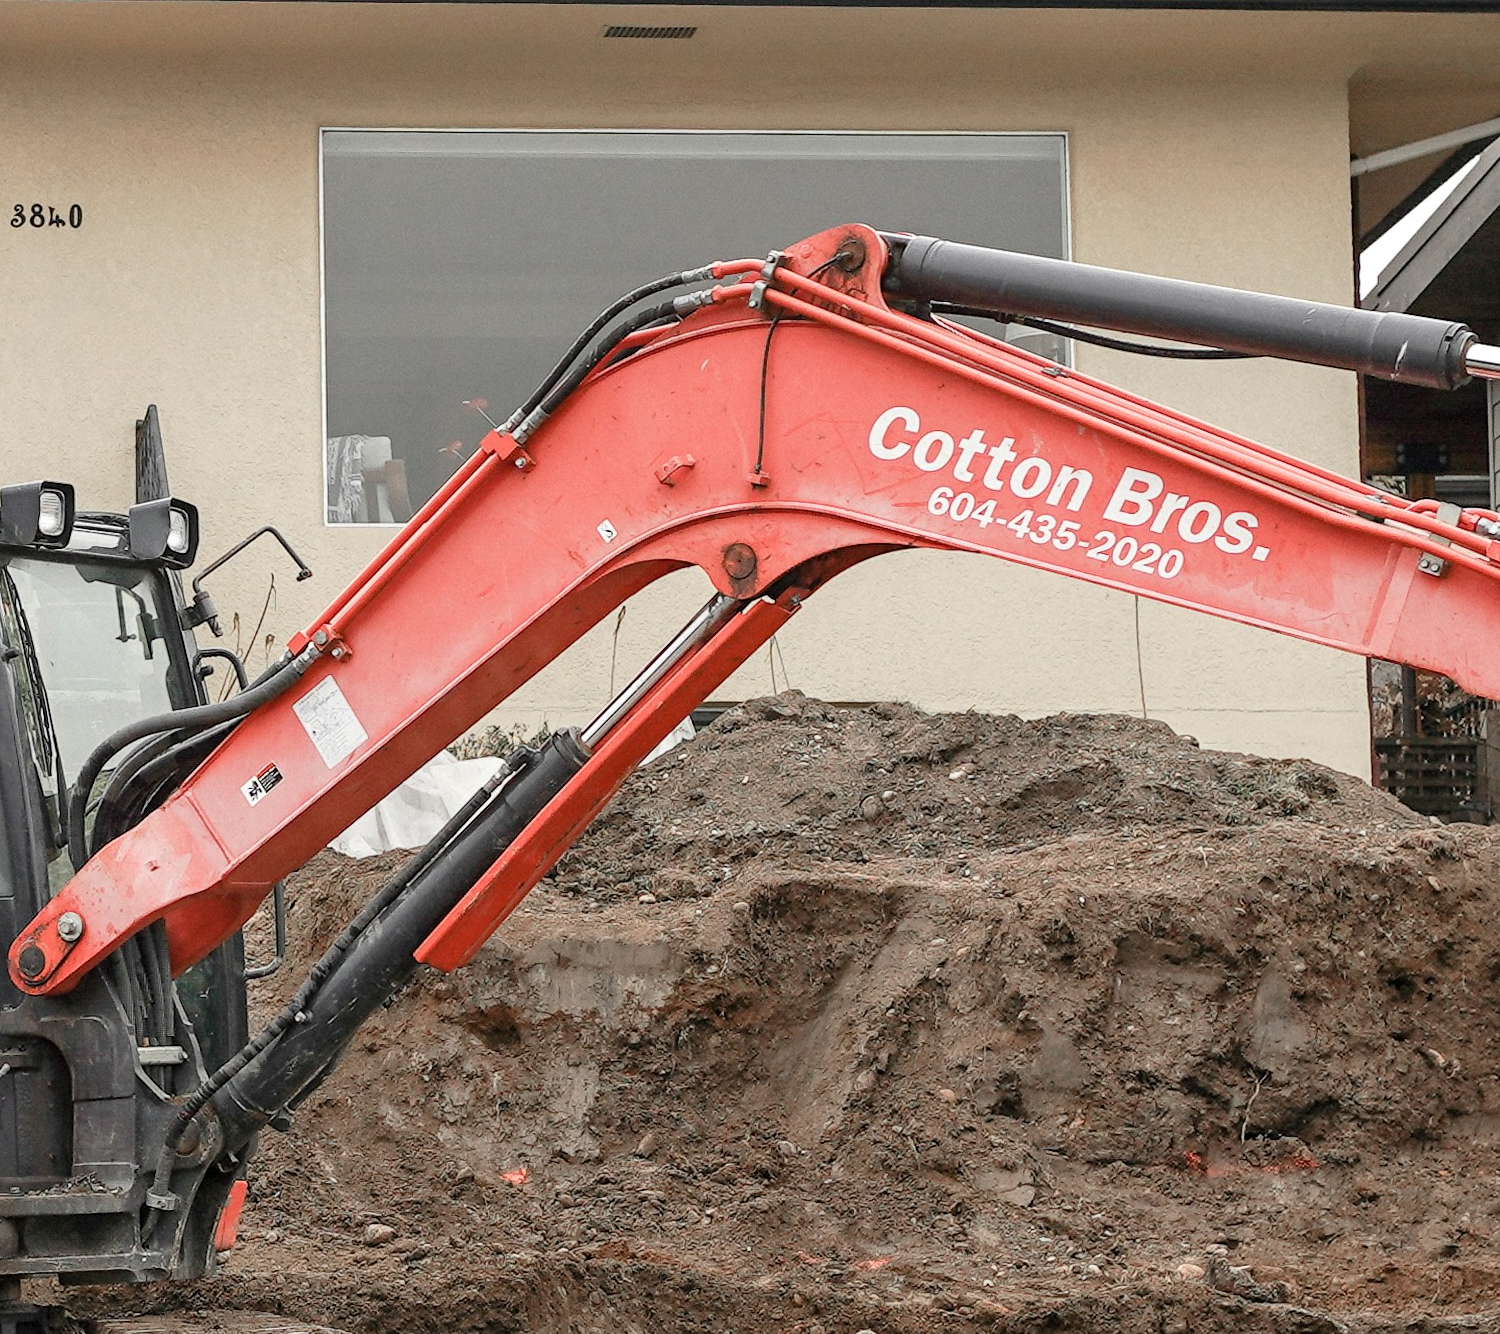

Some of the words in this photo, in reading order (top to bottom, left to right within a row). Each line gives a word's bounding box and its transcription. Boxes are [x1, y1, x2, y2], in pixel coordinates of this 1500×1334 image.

[10, 204, 83, 228] 3840
[868, 406, 1093, 512] Cotton
[1103, 467, 1271, 562] Bros.
[927, 486, 1184, 579] 604-435-2020
